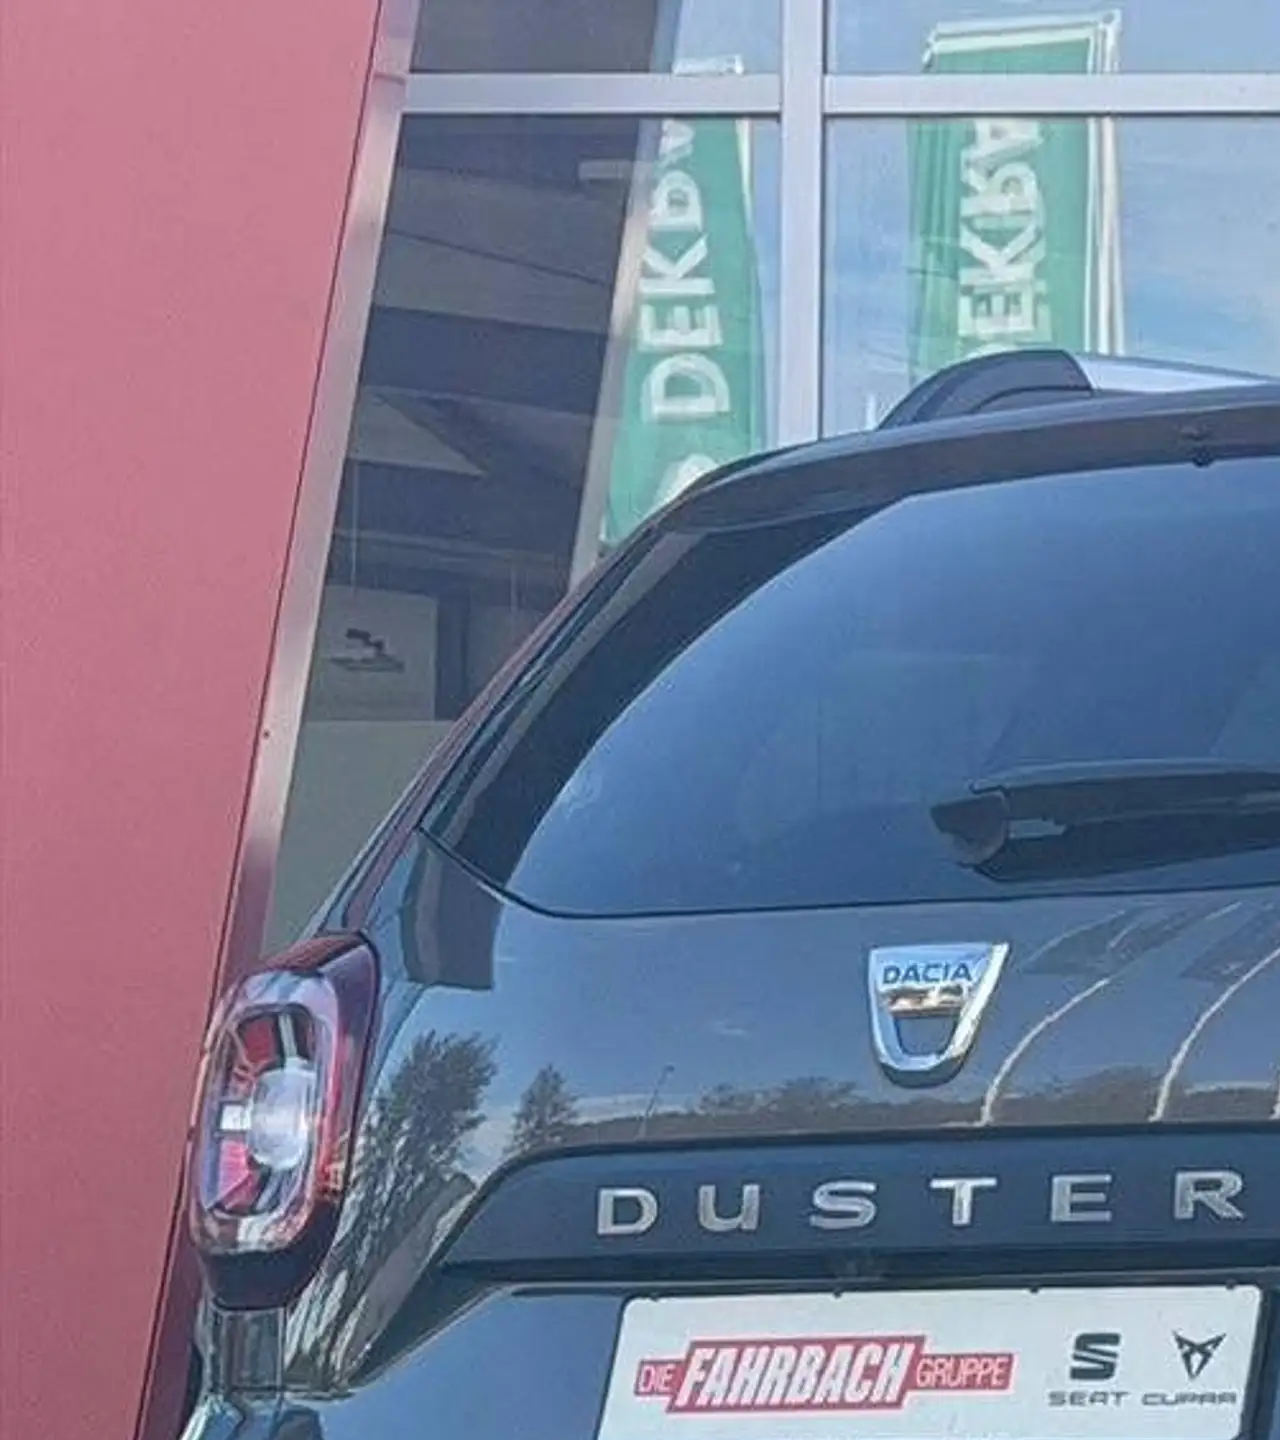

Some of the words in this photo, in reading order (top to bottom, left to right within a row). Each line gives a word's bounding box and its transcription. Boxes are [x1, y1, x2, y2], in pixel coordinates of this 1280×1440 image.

[883, 962, 971, 985] DACIA
[597, 1170, 1244, 1235] DUSTER
[639, 1364, 674, 1393] DIE
[676, 1342, 914, 1407] FAHRBACH
[916, 1355, 1010, 1388] GRUPPE
[1047, 1390, 1129, 1406] SEAT
